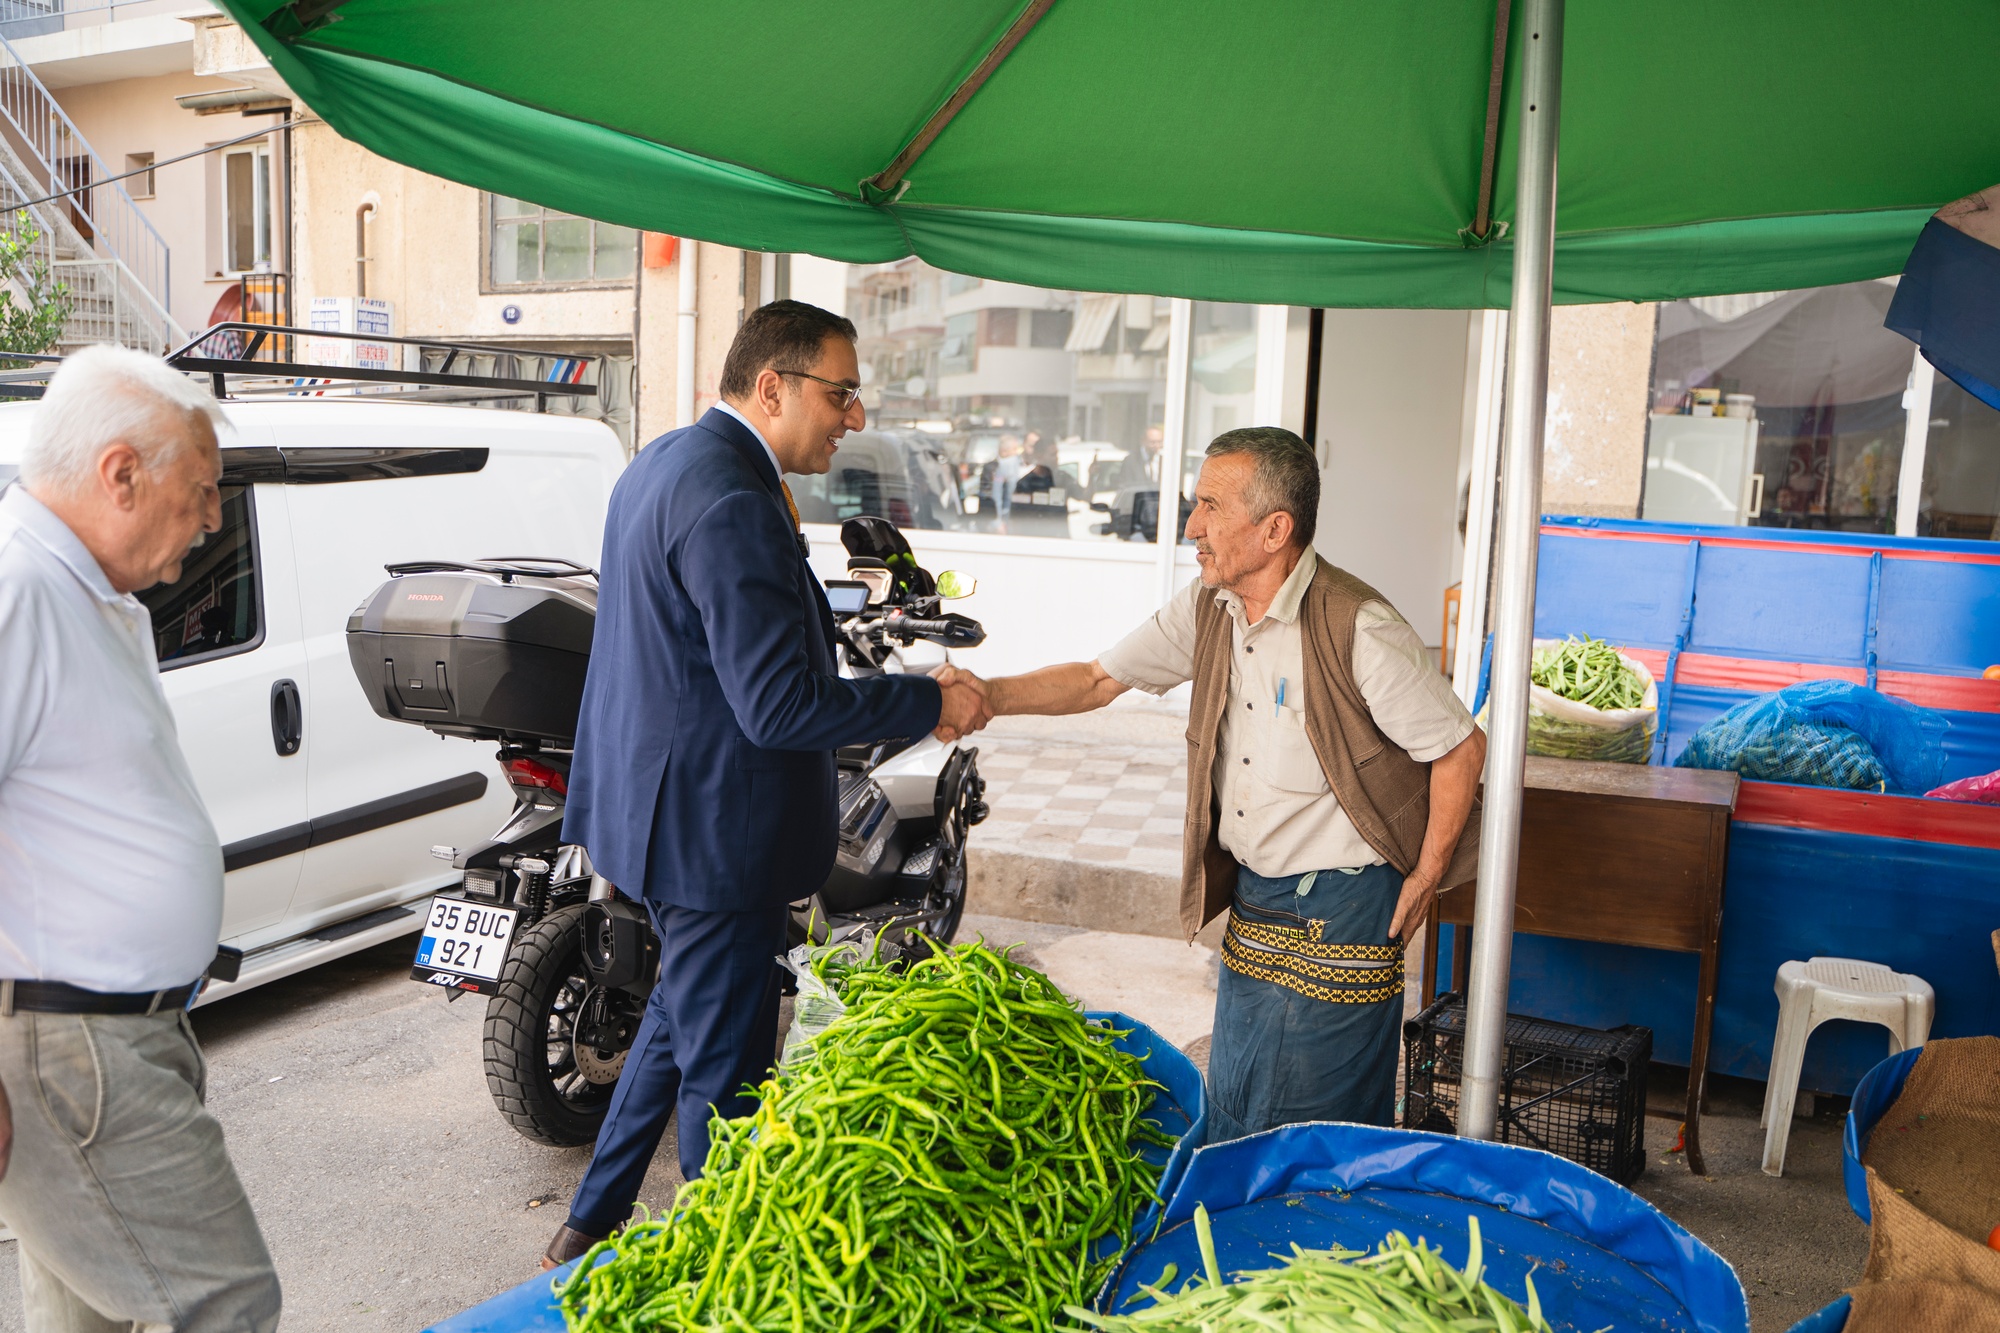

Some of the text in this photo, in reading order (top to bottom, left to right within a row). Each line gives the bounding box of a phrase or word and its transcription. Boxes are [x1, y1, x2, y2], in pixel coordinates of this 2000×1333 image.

[431, 904, 510, 940] 35 BUC
[420, 953, 430, 963] TR
[440, 939, 483, 969] 921
[427, 972, 465, 987] ADV
